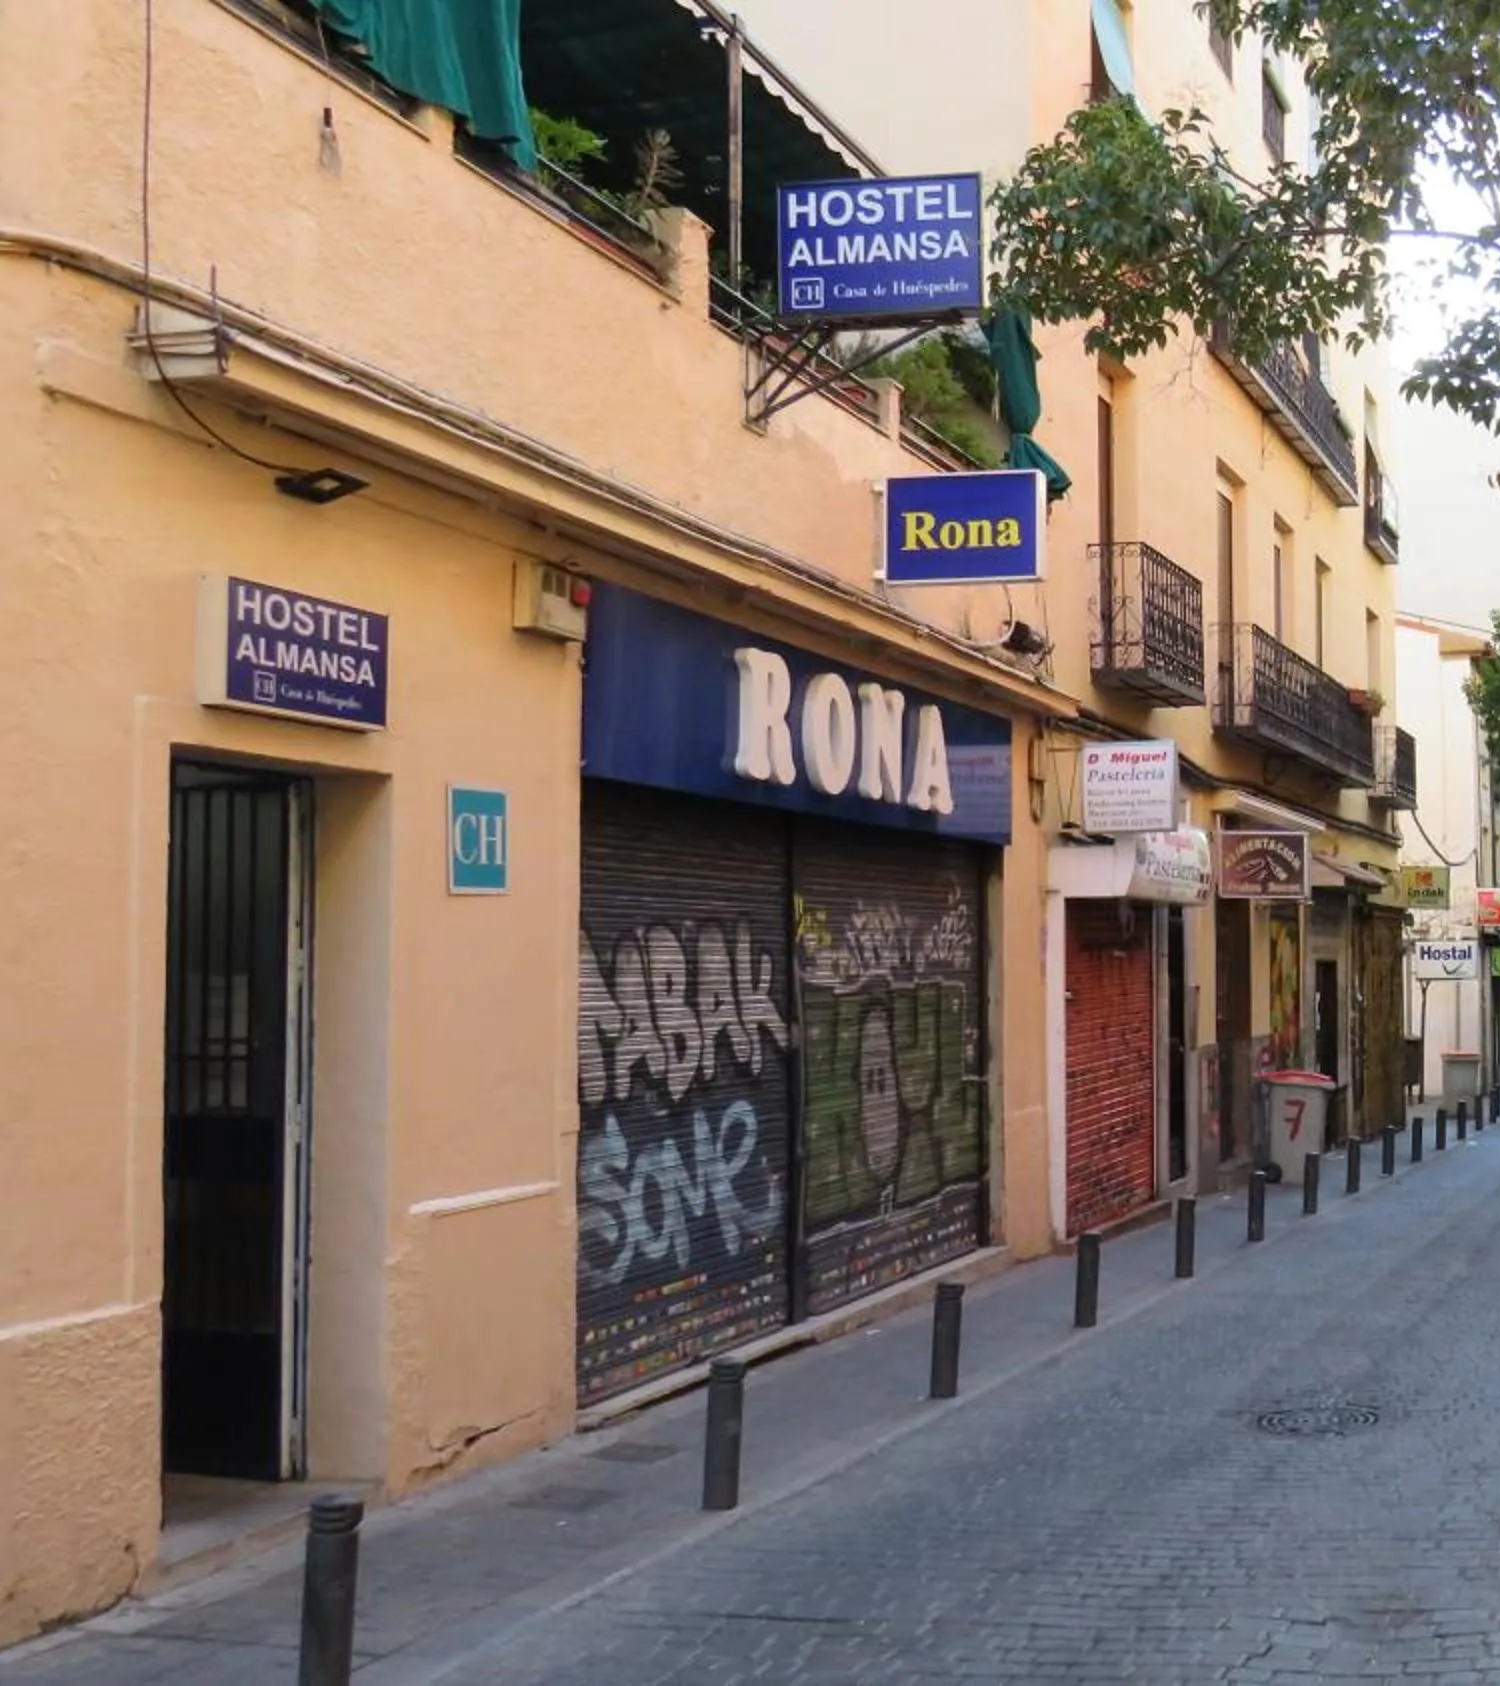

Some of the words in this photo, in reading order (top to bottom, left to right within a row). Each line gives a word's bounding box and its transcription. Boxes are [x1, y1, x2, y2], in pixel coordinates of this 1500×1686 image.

[787, 183, 973, 229] HOSTEL
[787, 229, 969, 267] ALMANSA
[833, 283, 868, 299] Casa
[873, 283, 887, 297] de
[893, 275, 970, 298] Huéspedes
[901, 510, 1021, 551] Rona
[236, 584, 379, 651] HOSTEL
[235, 632, 376, 688] ALMANSA
[734, 647, 954, 816] RONA
[1110, 751, 1167, 765] Miguel
[454, 812, 504, 865] CH
[1420, 945, 1473, 961] Hostal
[1284, 1099, 1306, 1141] 7
